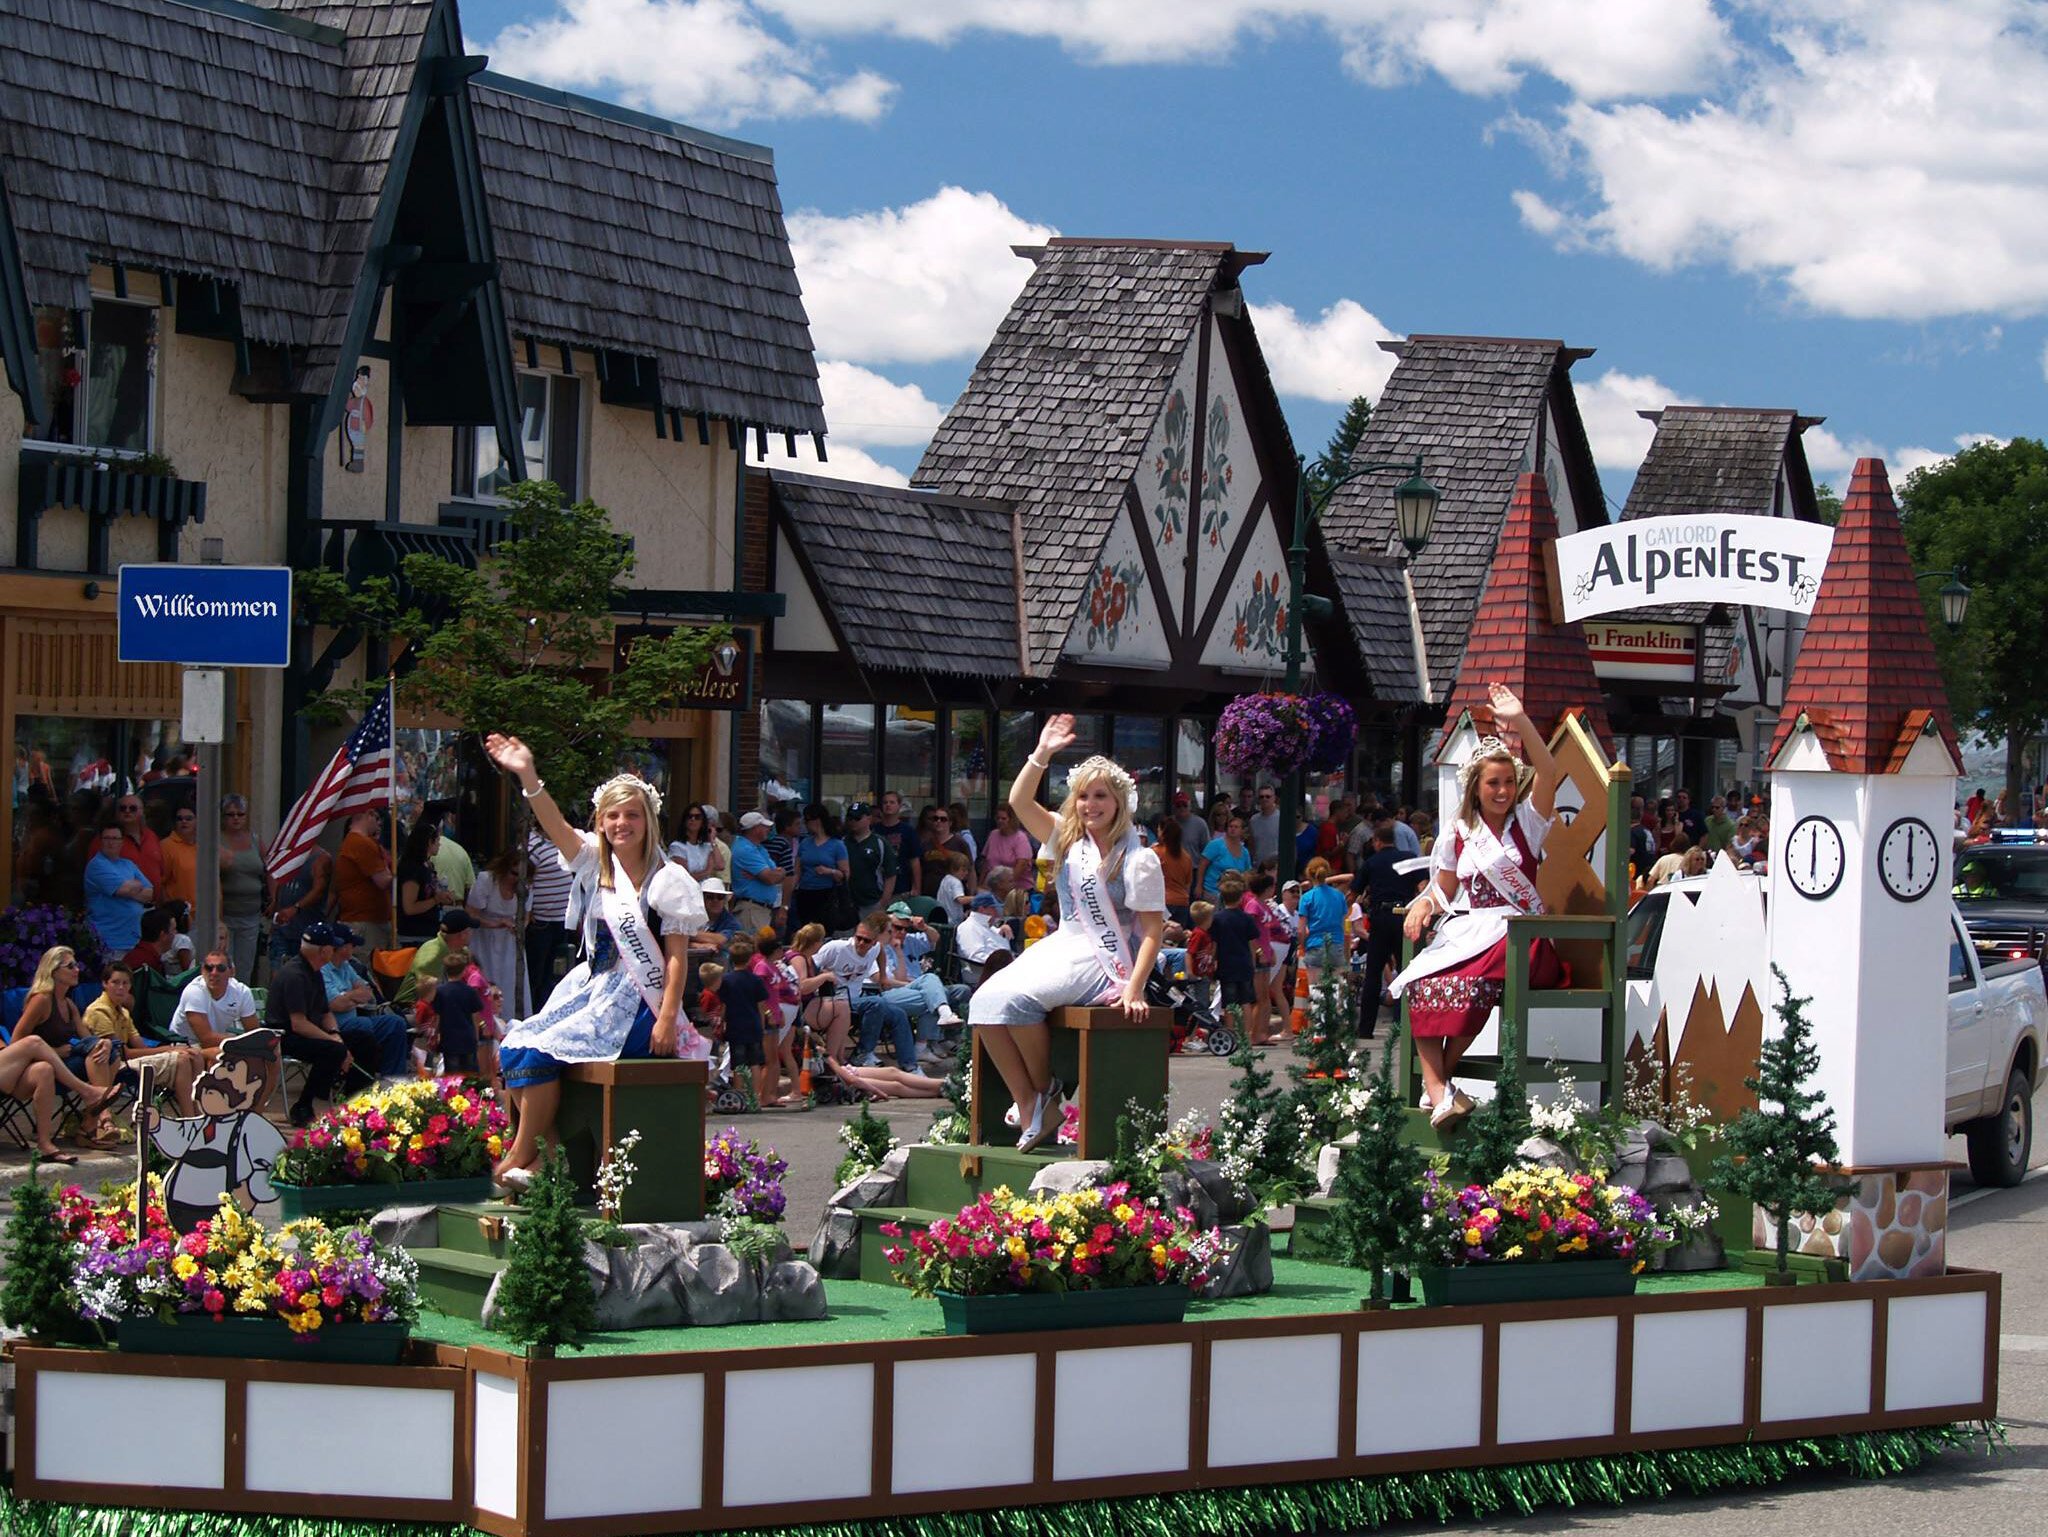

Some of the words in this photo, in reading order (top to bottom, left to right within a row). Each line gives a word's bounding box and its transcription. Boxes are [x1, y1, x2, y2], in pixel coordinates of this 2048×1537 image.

[1645, 525, 1717, 547] GAYLORD
[134, 594, 278, 618] Willkommen
[1605, 629, 1682, 650] Franklin
[1080, 874, 1108, 928] Runner
[1099, 930, 1119, 953] Up
[618, 912, 653, 964] Runner
[644, 966, 663, 990] Up
